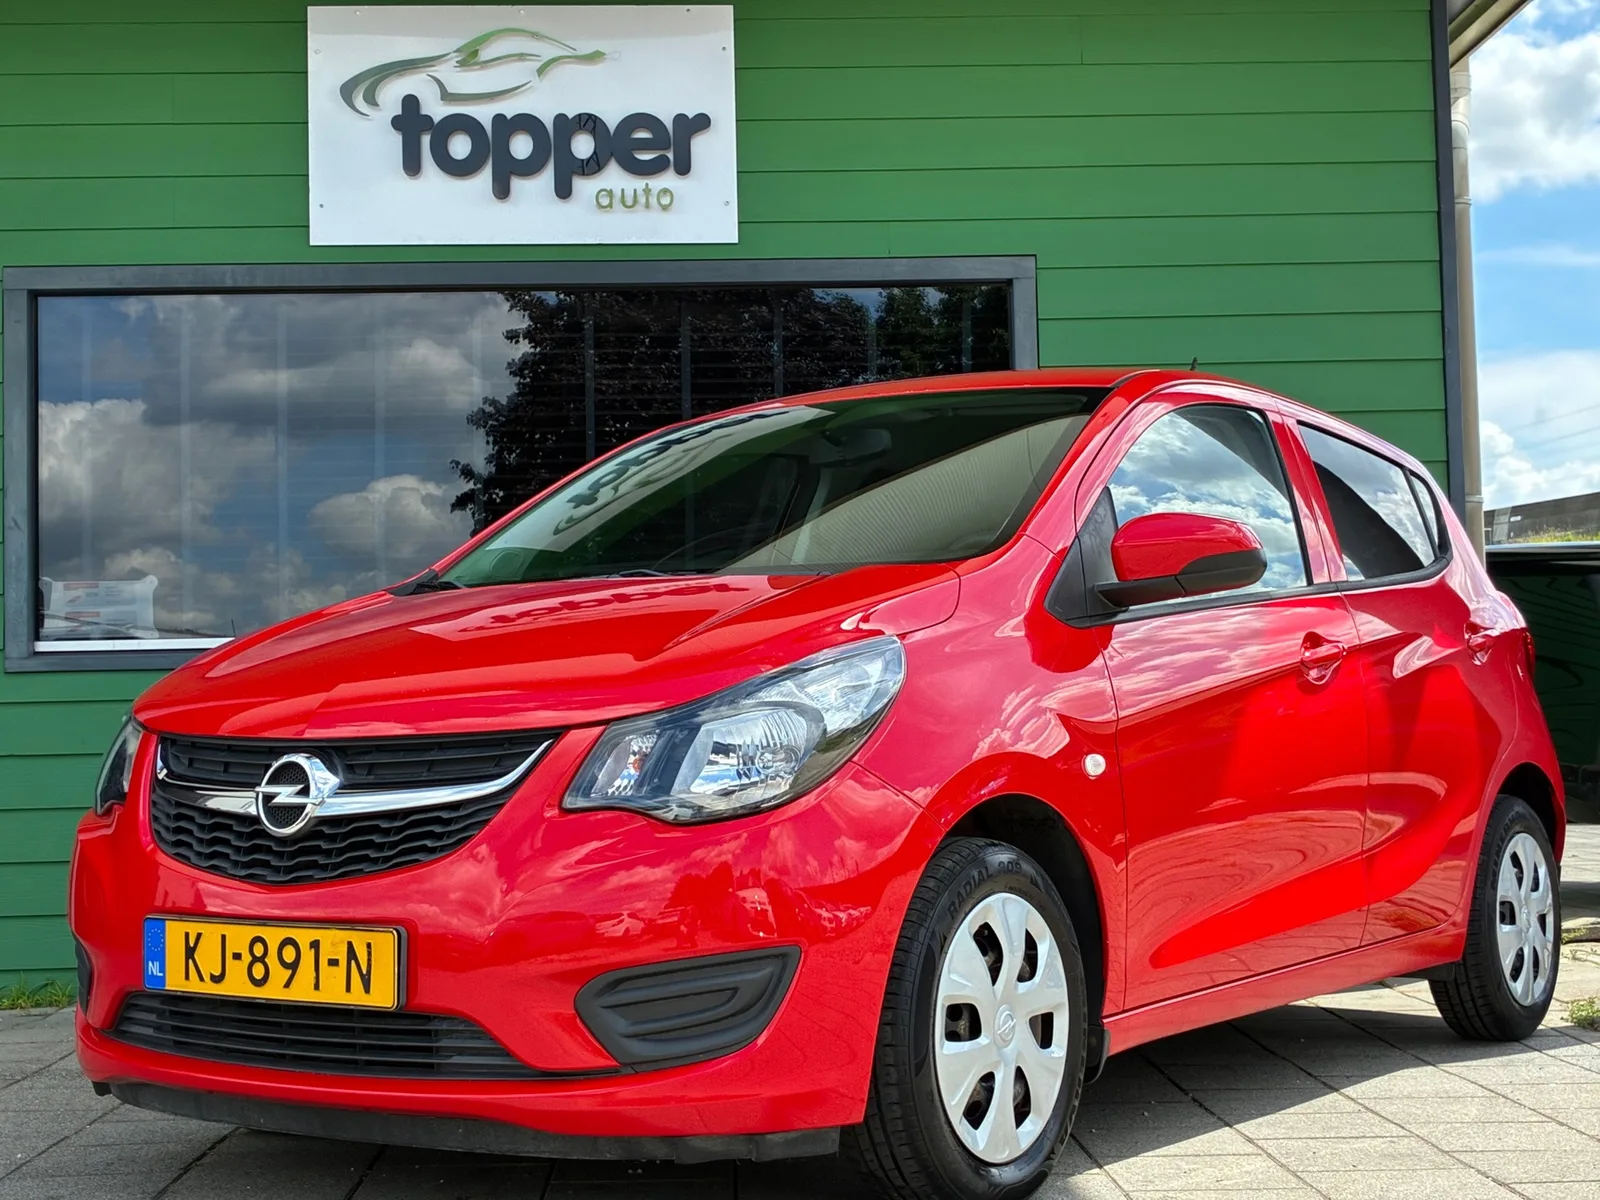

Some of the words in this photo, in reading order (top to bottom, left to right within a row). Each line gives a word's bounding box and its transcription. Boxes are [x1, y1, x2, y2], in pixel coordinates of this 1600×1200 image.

[390, 94, 711, 200] topper
[595, 182, 674, 209] auto
[947, 865, 993, 919] RADIAL
[148, 960, 163, 976] NL
[183, 931, 373, 994] KJ-891-N
